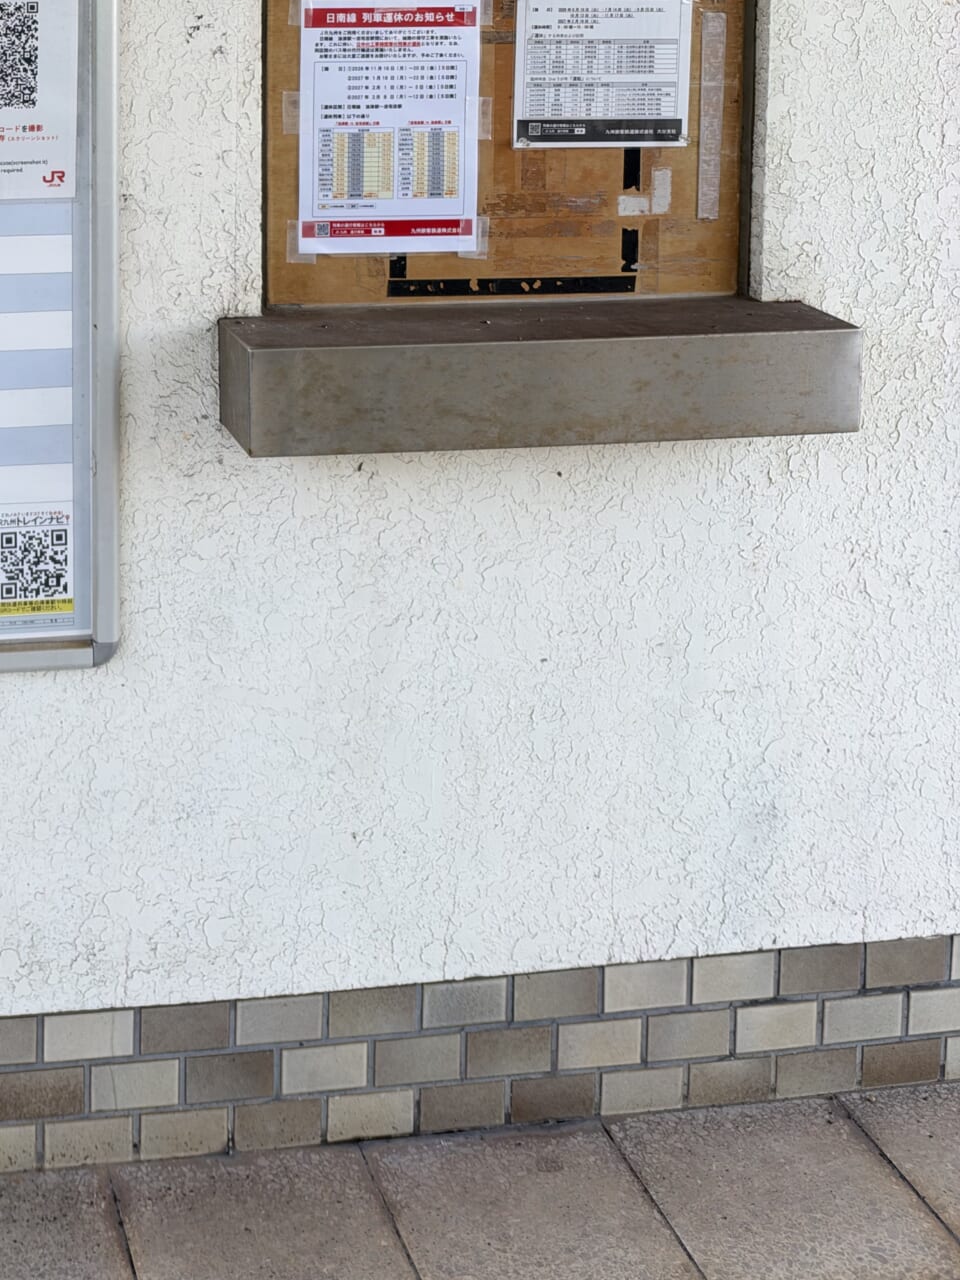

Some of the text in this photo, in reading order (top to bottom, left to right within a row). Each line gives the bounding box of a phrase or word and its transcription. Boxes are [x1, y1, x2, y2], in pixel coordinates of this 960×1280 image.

[326, 11, 455, 23] 日南線 列車運休のお知らせ
[43, 170, 65, 183] JR
